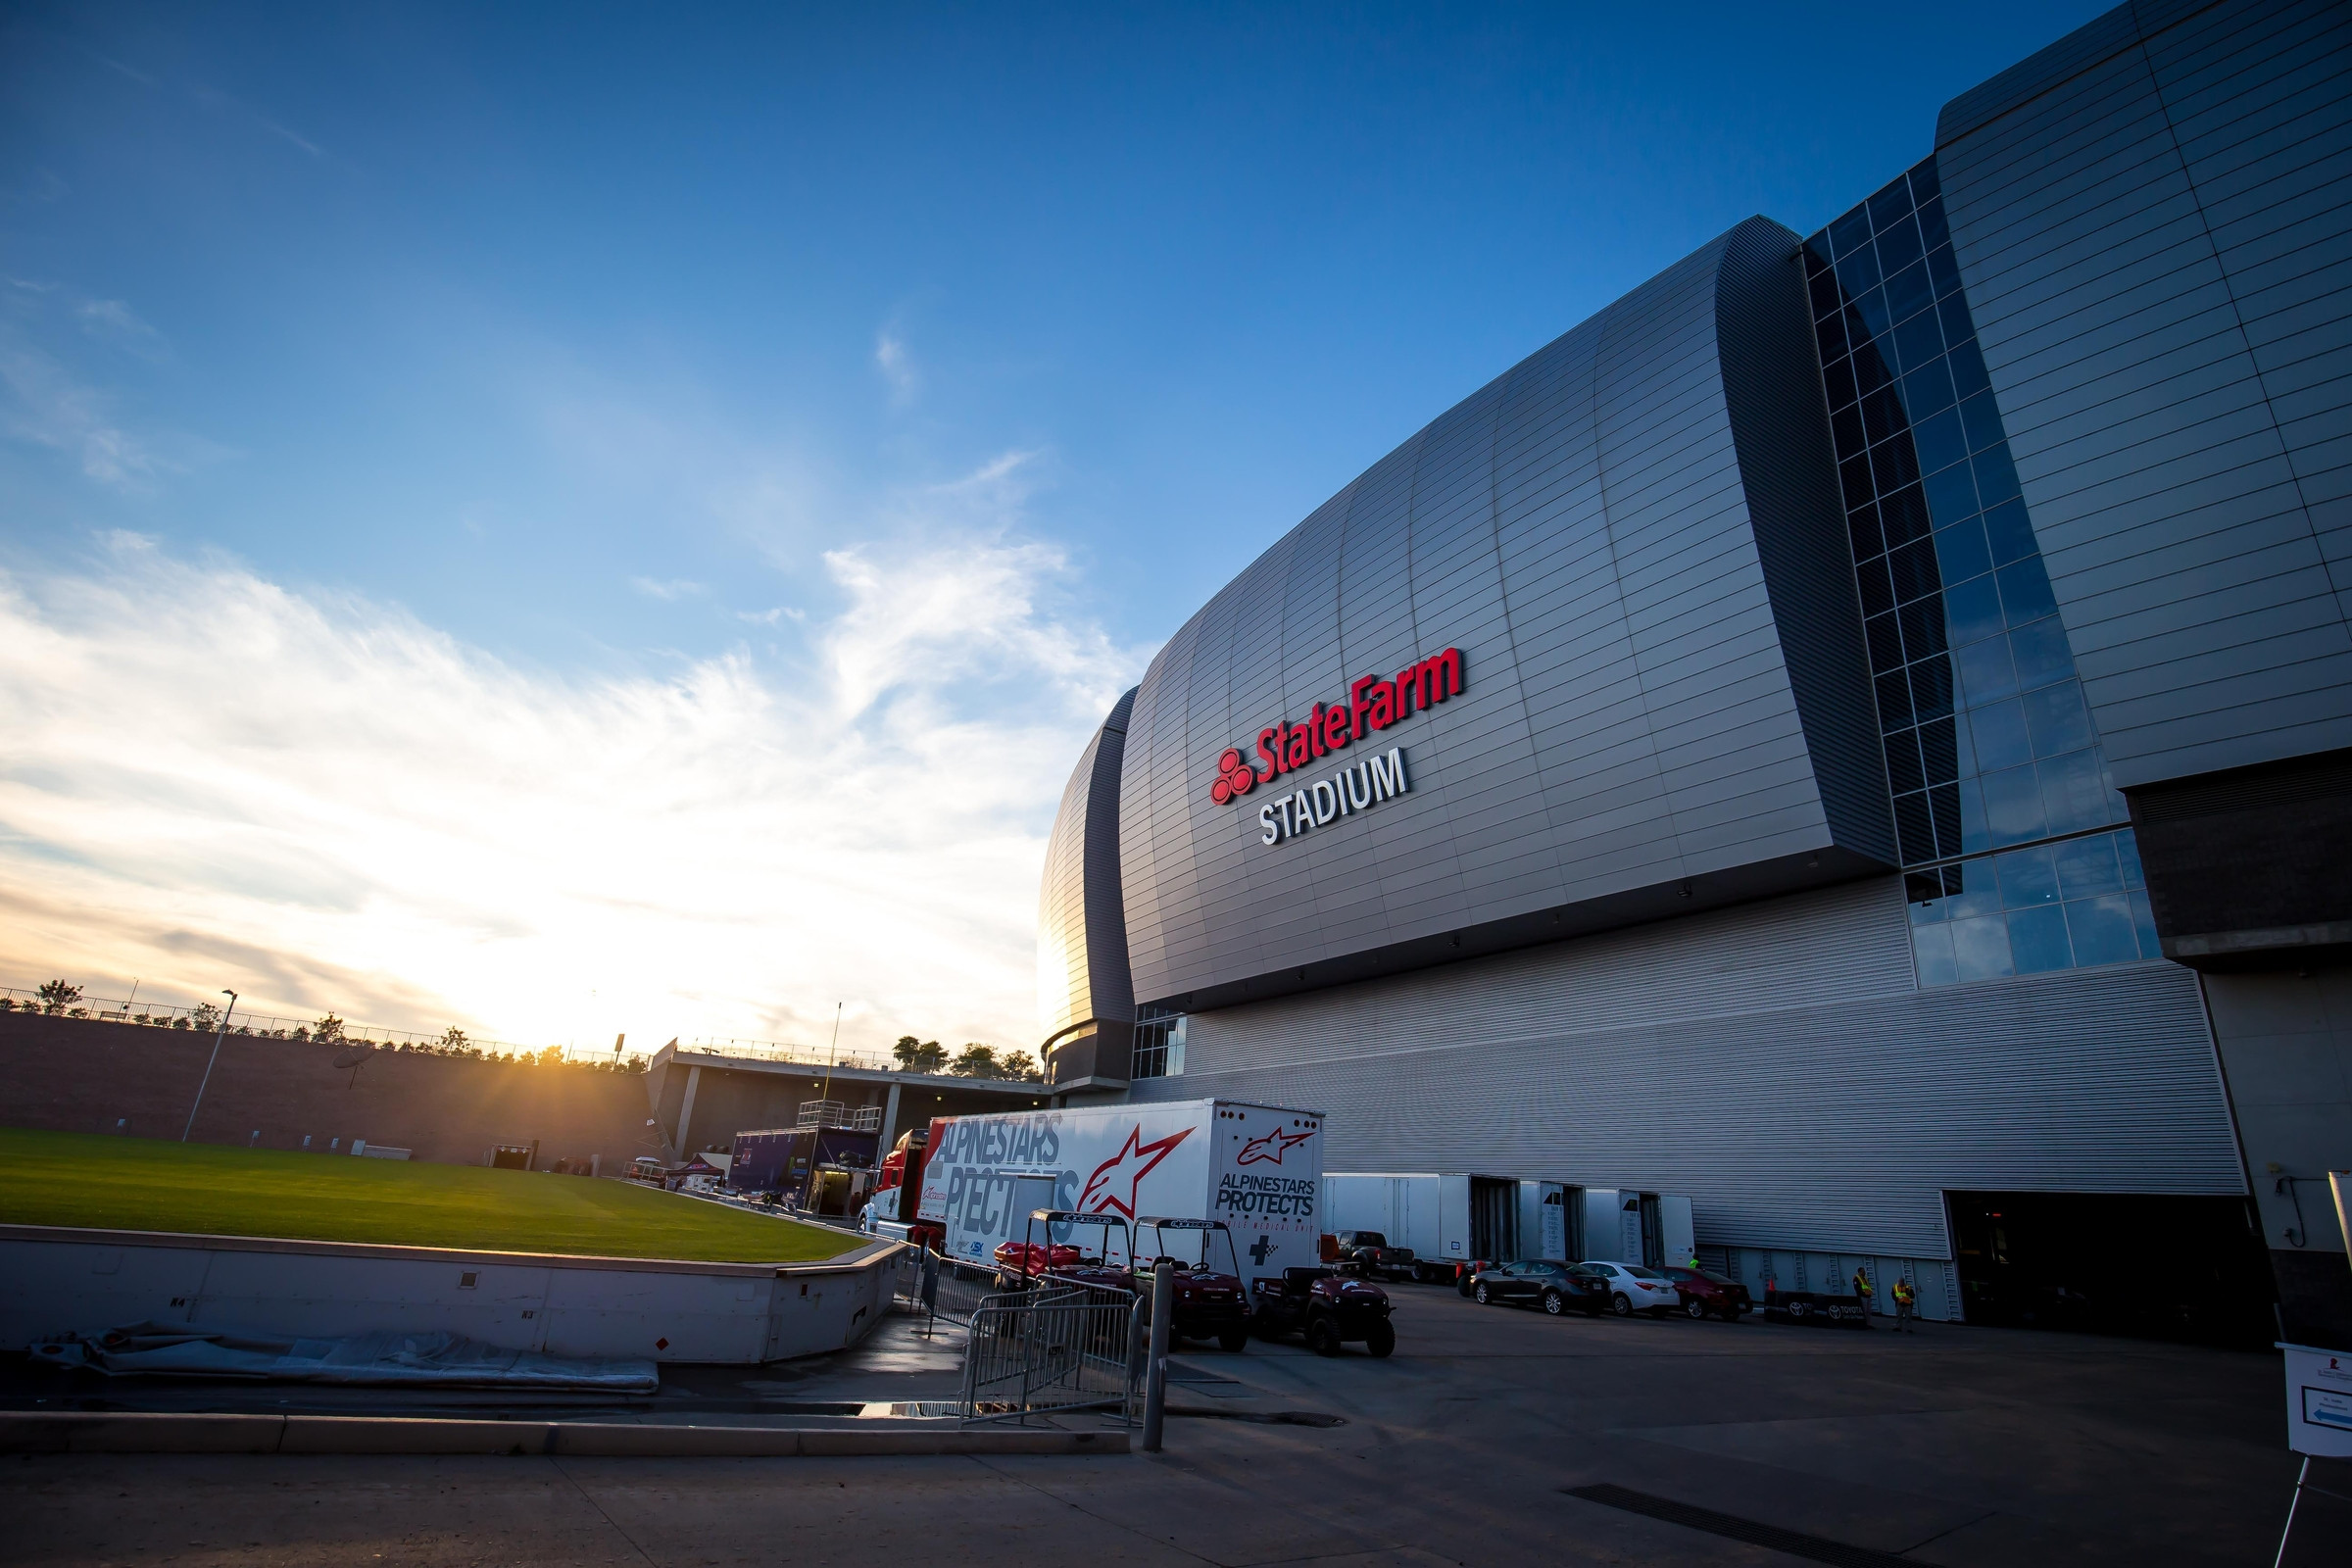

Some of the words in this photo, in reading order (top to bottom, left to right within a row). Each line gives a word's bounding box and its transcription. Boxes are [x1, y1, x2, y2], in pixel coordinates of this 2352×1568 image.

[1259, 747, 1407, 845] STADIUM
[936, 1113, 1062, 1165] ALPINESTARS
[1220, 1173, 1315, 1195] ALPINESTARS
[1215, 1189, 1313, 1216] PROTECTS
[1253, 1222, 1290, 1232] MEDICAL
